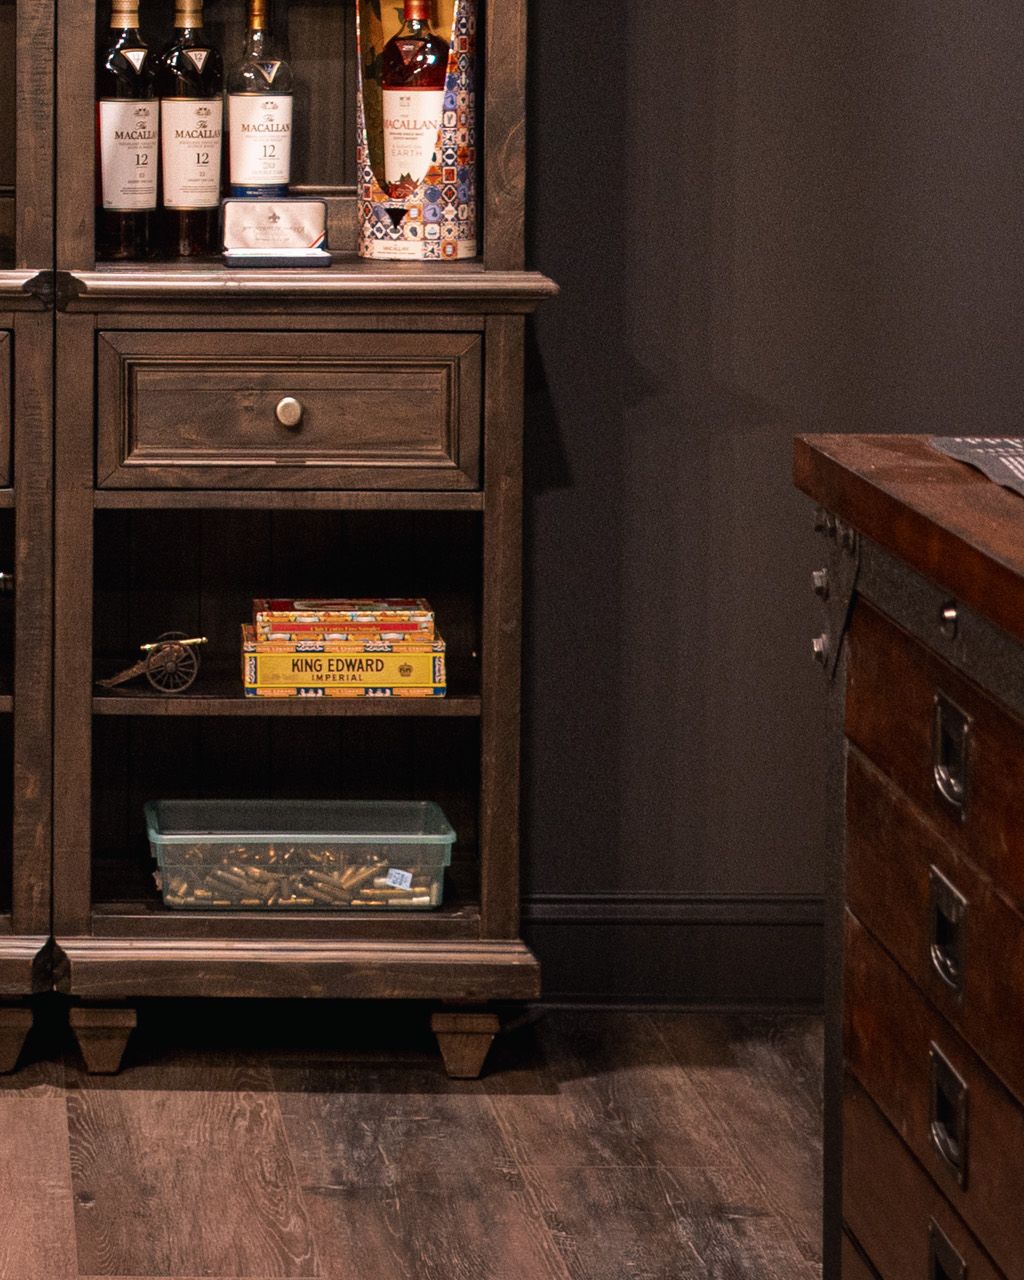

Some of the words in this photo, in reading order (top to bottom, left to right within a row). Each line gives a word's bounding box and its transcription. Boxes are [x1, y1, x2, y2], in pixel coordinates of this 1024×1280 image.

[114, 131, 156, 140] MACALLA
[262, 144, 276, 157] 12
[136, 154, 148, 166] 12
[195, 152, 209, 164] 12
[292, 658, 322, 672] KING
[328, 658, 384, 672] EDWARD
[312, 674, 363, 682] IMPERIAL
